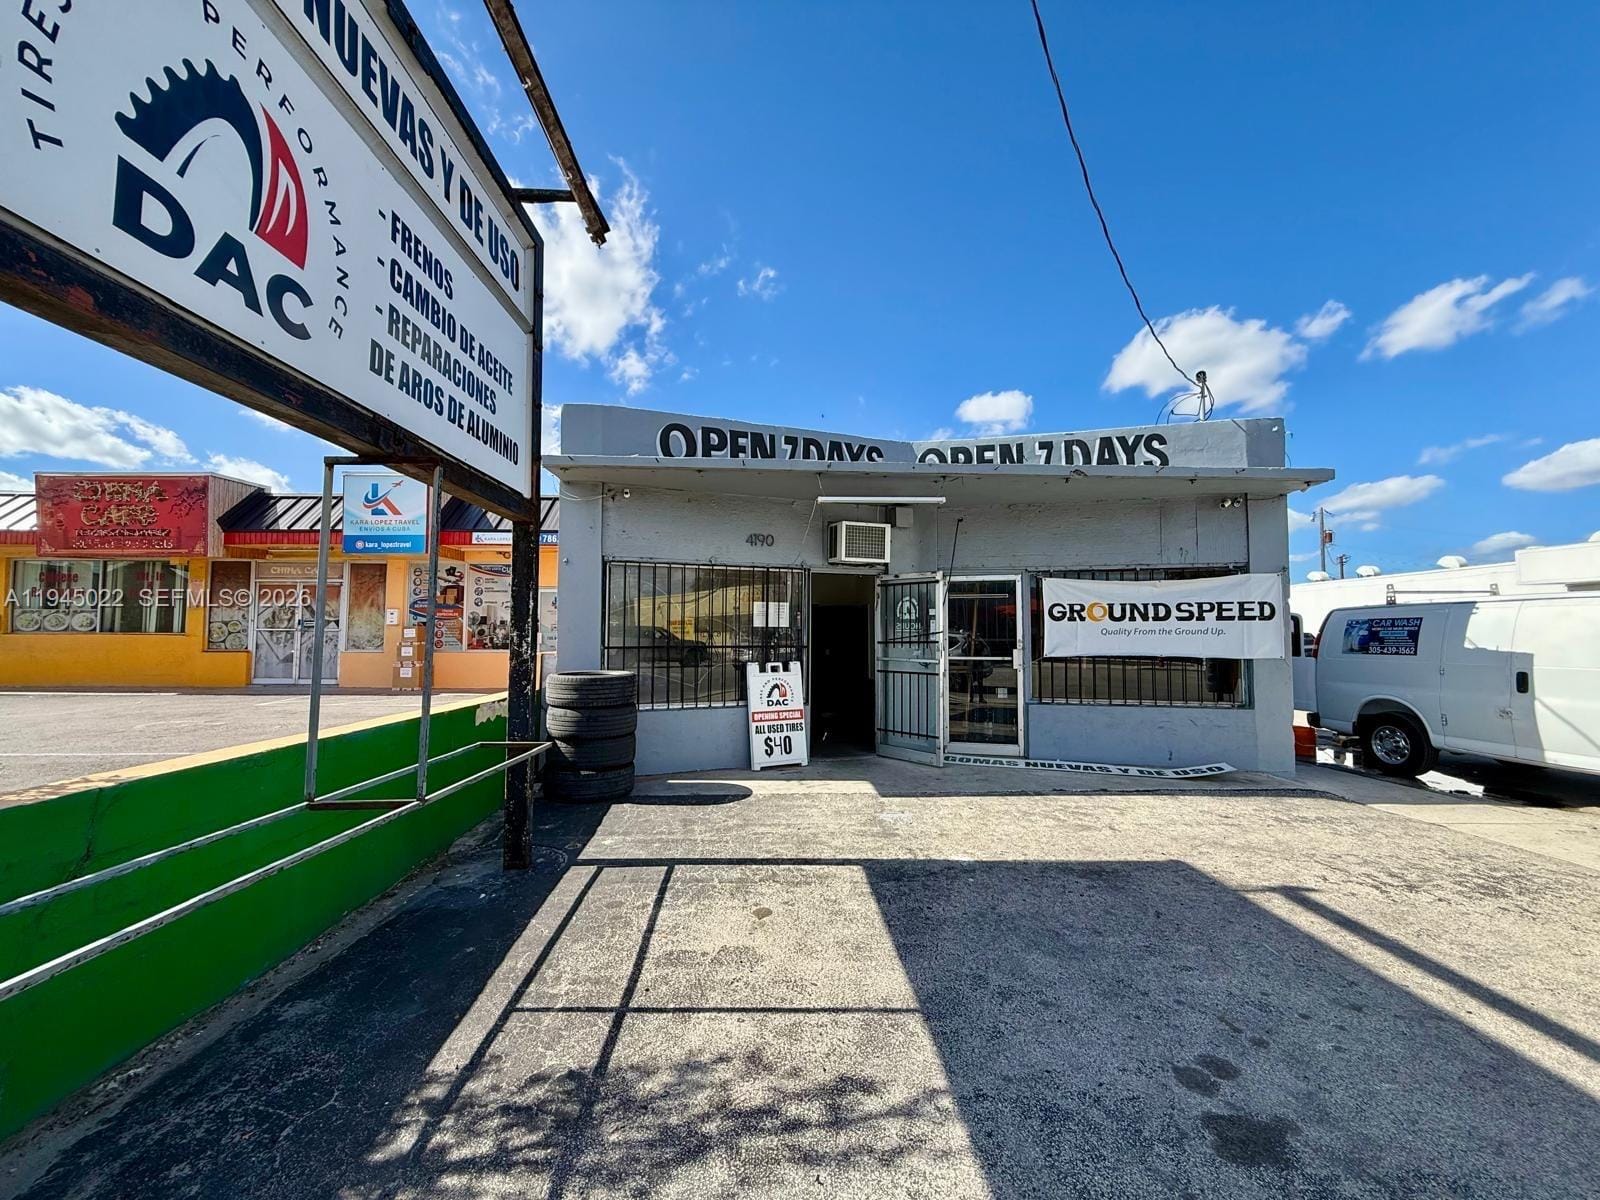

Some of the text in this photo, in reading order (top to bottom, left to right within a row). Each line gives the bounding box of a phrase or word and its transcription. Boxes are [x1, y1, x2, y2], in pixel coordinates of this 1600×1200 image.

[17, 0, 73, 151] TIRE
[303, 0, 520, 293] NUEVAS Y DE USO
[202, 0, 351, 340] PERFORMANCE
[112, 154, 314, 341] DAC
[390, 209, 454, 300] FRENOS
[389, 257, 513, 397] CAMBIO DE ACEITE
[387, 302, 497, 416] REPARACIONES
[369, 337, 519, 467] DE AROS DE ALUMINIO
[657, 422, 776, 460] OPEN
[803, 436, 885, 462] DAYS
[917, 433, 1168, 466] OPEN 7 DAYS
[746, 533, 775, 547] 4190
[1100, 627, 1227, 637] Quality From the Ground Up.
[1372, 618, 1420, 627] CAR WASH
[1368, 646, 1415, 655] 305-439-1562
[753, 710, 802, 720] OPENING SPECIAL
[767, 698, 789, 707] DAC
[755, 722, 804, 735] ALL USED TIRES
[764, 735, 793, 758] $40
[944, 755, 1019, 767] GOMAS
[1024, 761, 1112, 774] NUEVAS
[1118, 767, 1132, 775] Y
[1172, 766, 1226, 777] USO
